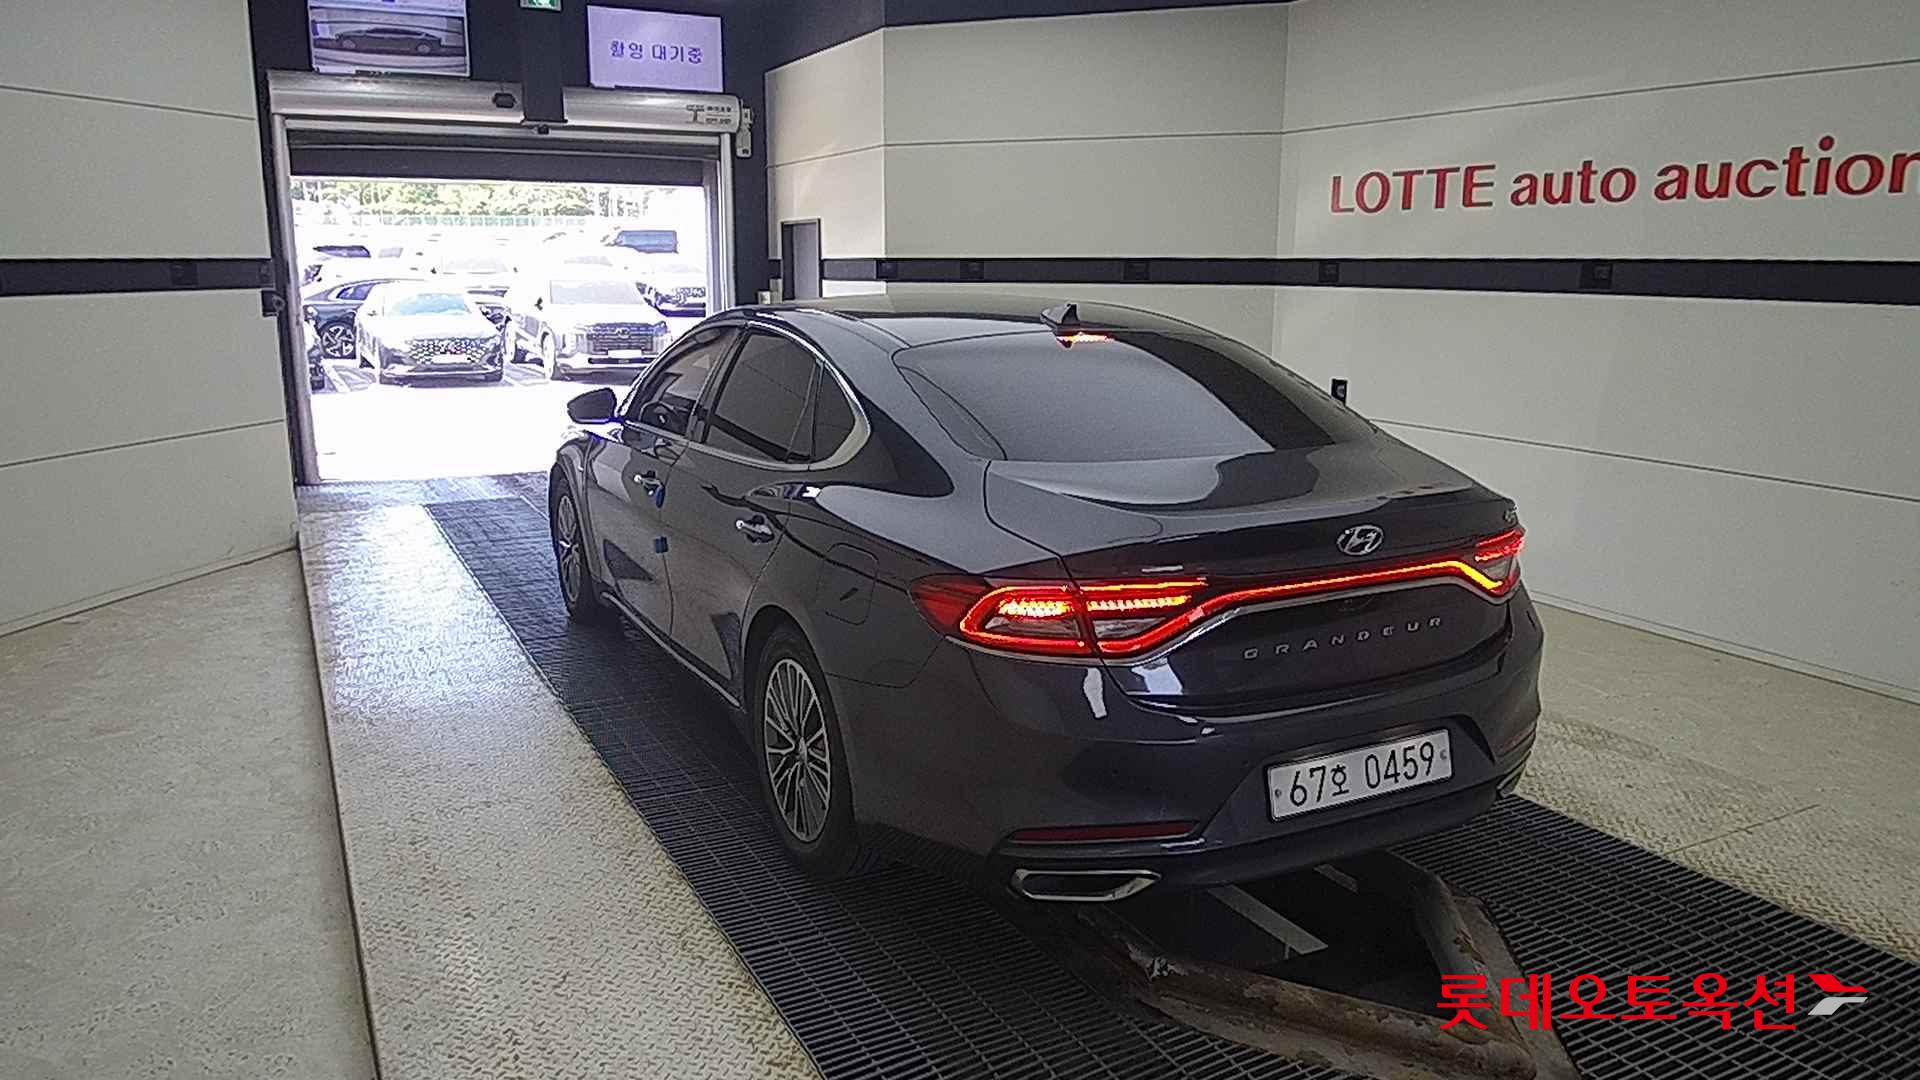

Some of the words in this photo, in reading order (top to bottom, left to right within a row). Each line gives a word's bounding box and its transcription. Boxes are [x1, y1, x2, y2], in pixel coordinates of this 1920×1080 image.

[651, 44, 703, 65] 대기중
[1330, 163, 1497, 214] LOTTE
[1510, 160, 1637, 206] auto
[1243, 615, 1443, 661] GRANDEUR
[1289, 763, 1350, 808] 67호
[1364, 741, 1435, 789] 0459
